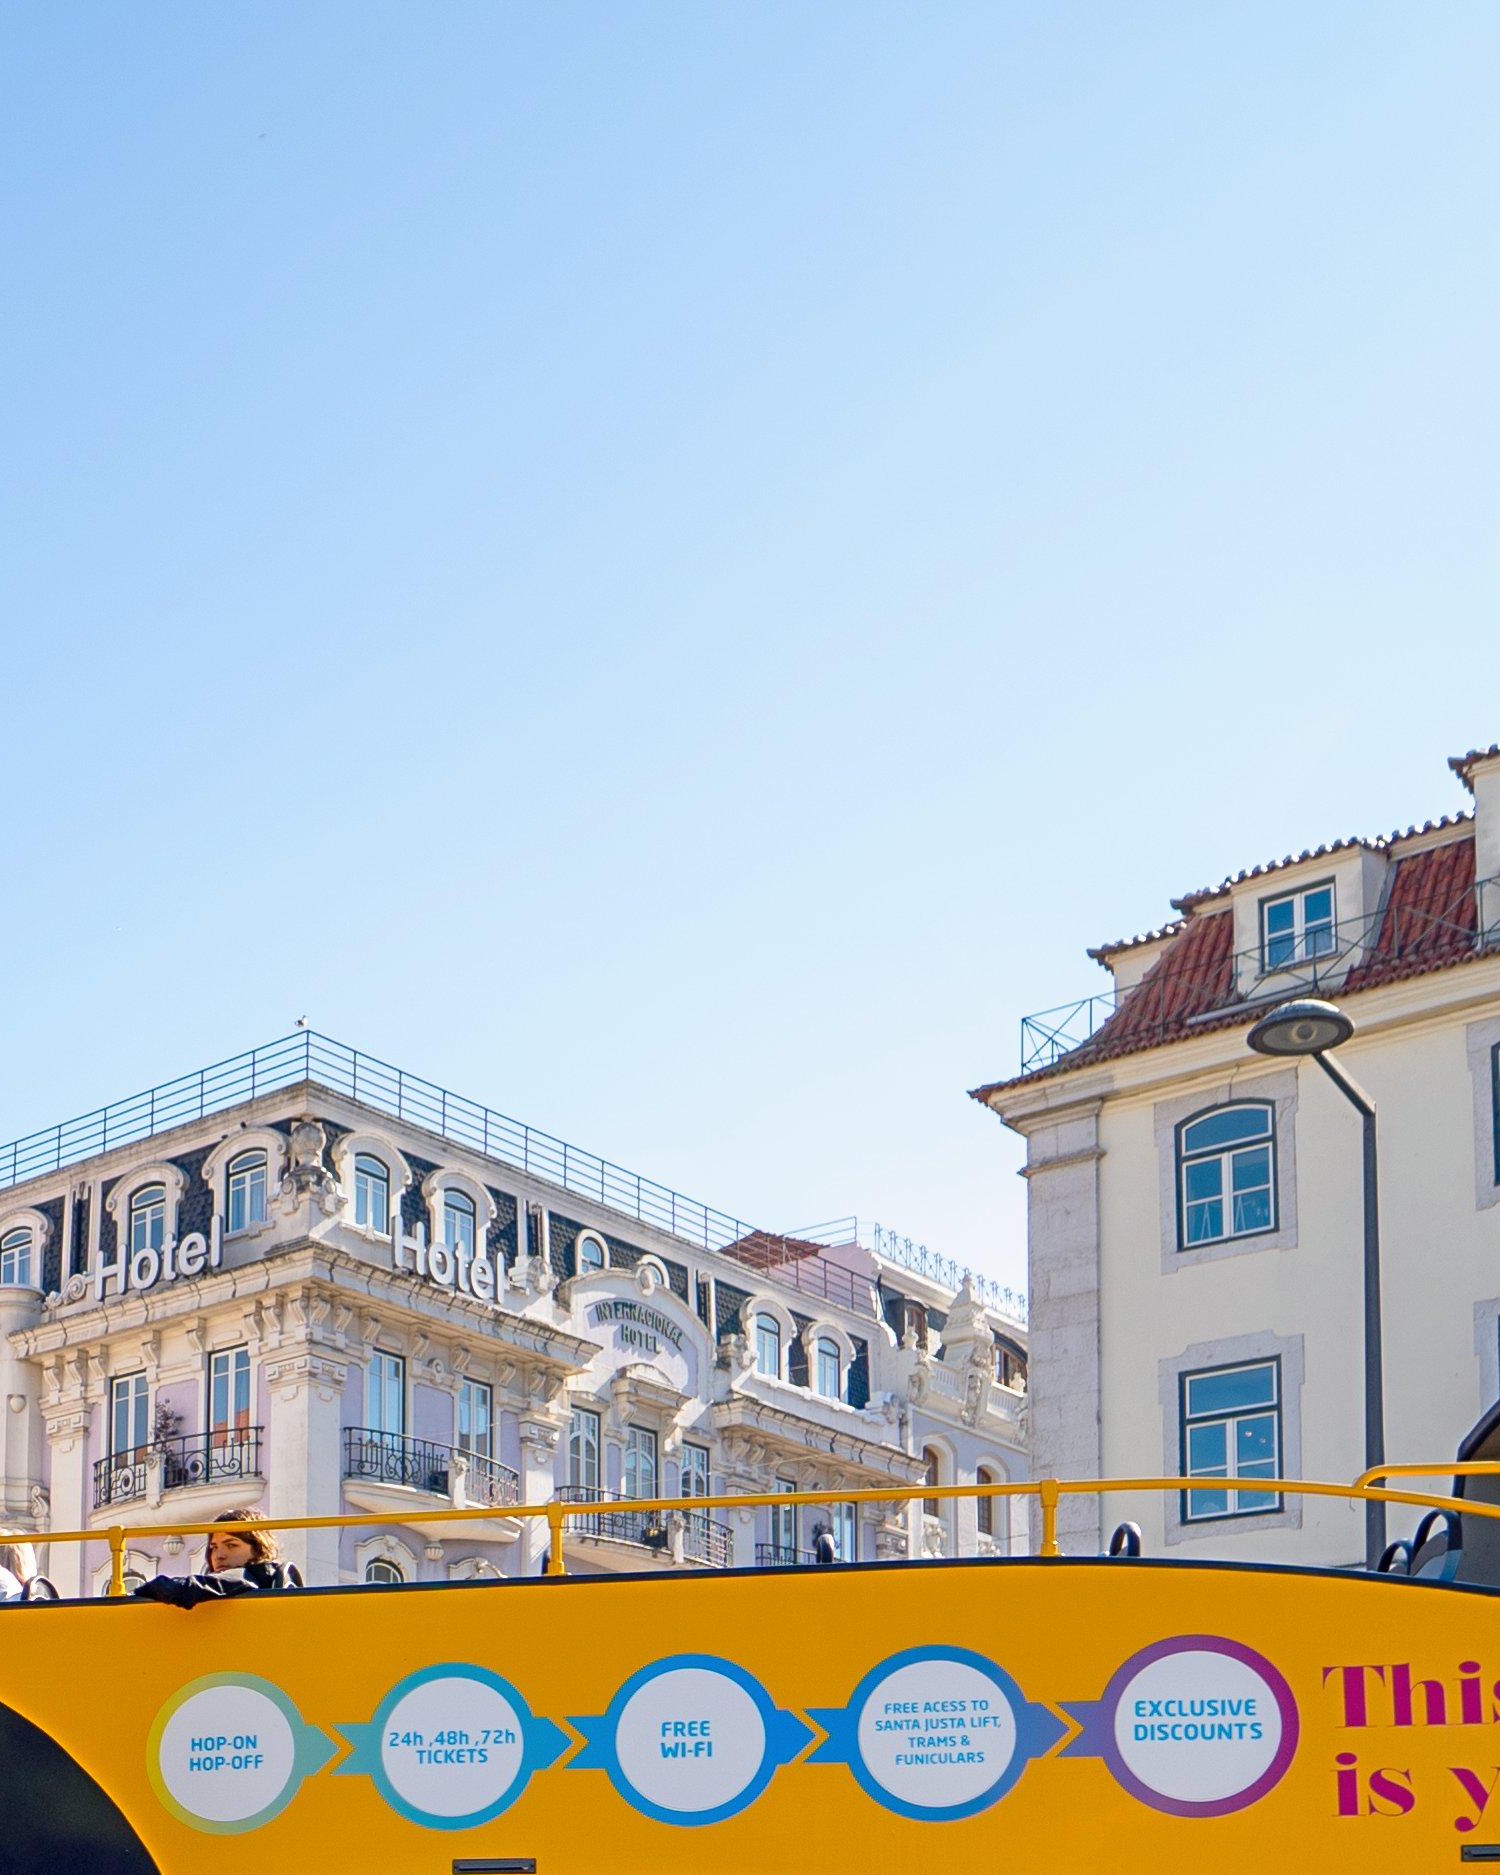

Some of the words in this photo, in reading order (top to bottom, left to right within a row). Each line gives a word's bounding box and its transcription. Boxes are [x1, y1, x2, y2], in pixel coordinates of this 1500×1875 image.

[95, 1212, 222, 1300] Hotel
[391, 1213, 506, 1304] Hotel
[594, 1301, 684, 1352] INTERNACIONAL
[620, 1323, 662, 1355] HOTEL
[884, 1702, 920, 1715] FREE
[922, 1701, 967, 1714] ACESS
[970, 1700, 990, 1712] TO
[1133, 1697, 1257, 1719] EXCLUSIVE
[660, 1720, 711, 1738] FREE
[875, 1718, 922, 1732] SANTA
[924, 1717, 968, 1732] JUSTA
[970, 1715, 1002, 1729] LIFT,
[1133, 1721, 1264, 1742] DISCOUNTS
[191, 1735, 258, 1752] HOP-ON
[389, 1731, 424, 1746] 24h
[908, 1736, 957, 1749] TRAMS
[960, 1734, 971, 1747] &
[416, 1748, 489, 1765] TICKETS
[660, 1740, 713, 1759] WI-FI
[189, 1754, 264, 1771] HOP-OFF
[895, 1752, 985, 1766] FUNICULARS
[1330, 1751, 1417, 1818] is
